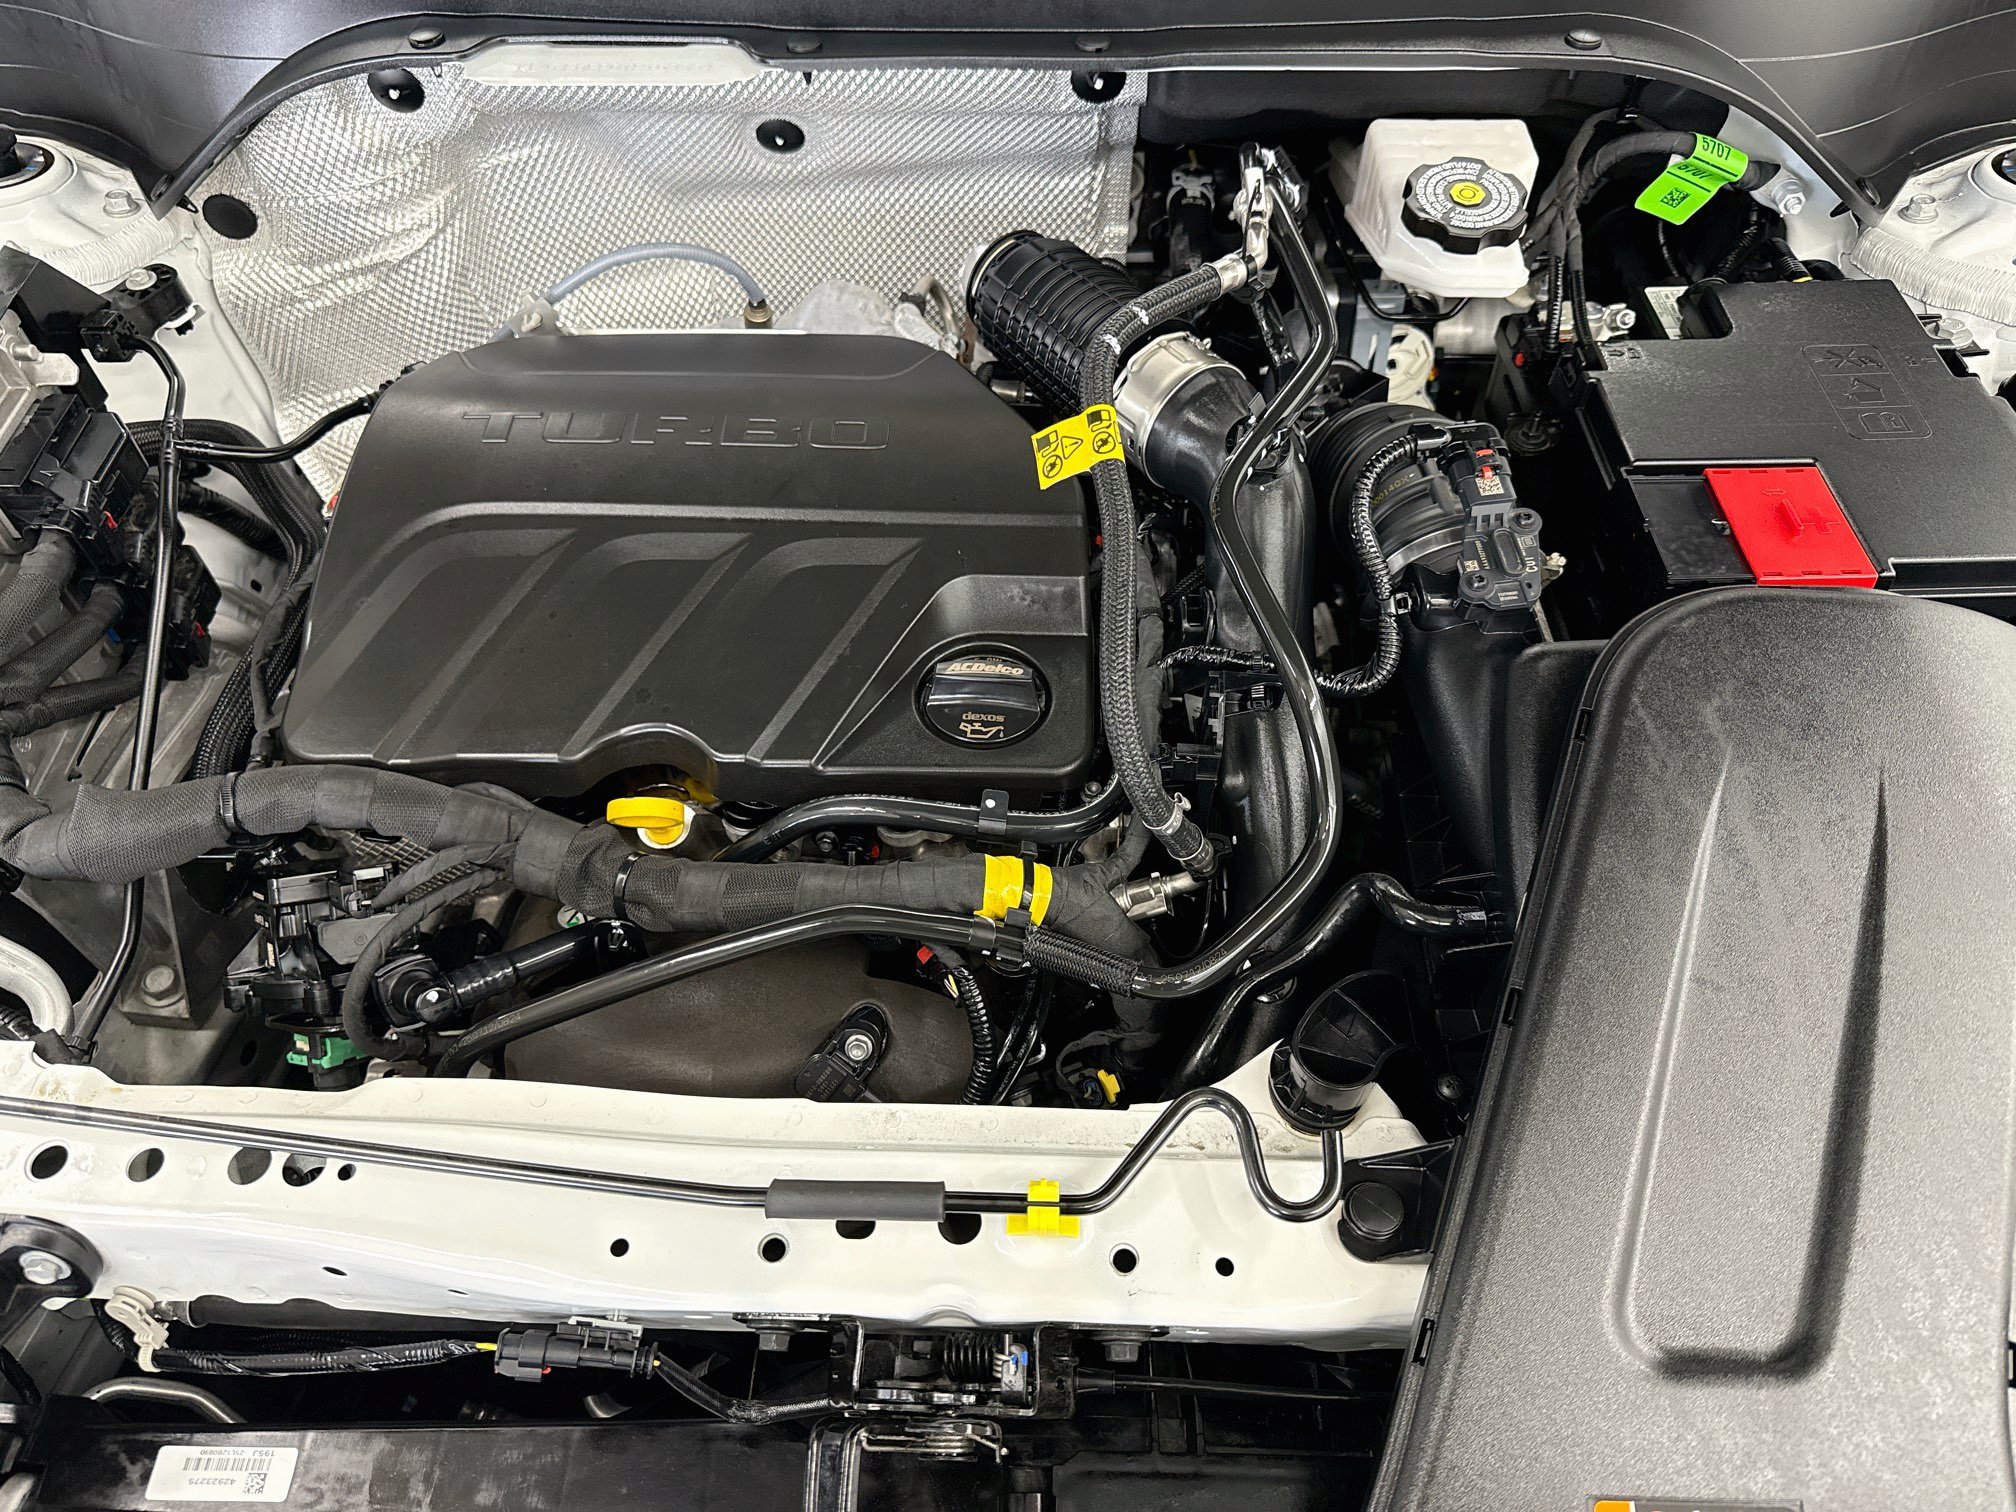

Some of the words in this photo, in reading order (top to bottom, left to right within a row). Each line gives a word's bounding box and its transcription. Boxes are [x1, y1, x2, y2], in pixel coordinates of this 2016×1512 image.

[1703, 137, 1731, 160] 5707
[1677, 163, 1711, 179] 5707
[462, 412, 890, 449] TURBO
[945, 662, 1024, 675] ACDelco
[962, 712, 1006, 722] dexos
[188, 1477, 236, 1485] 42923275
